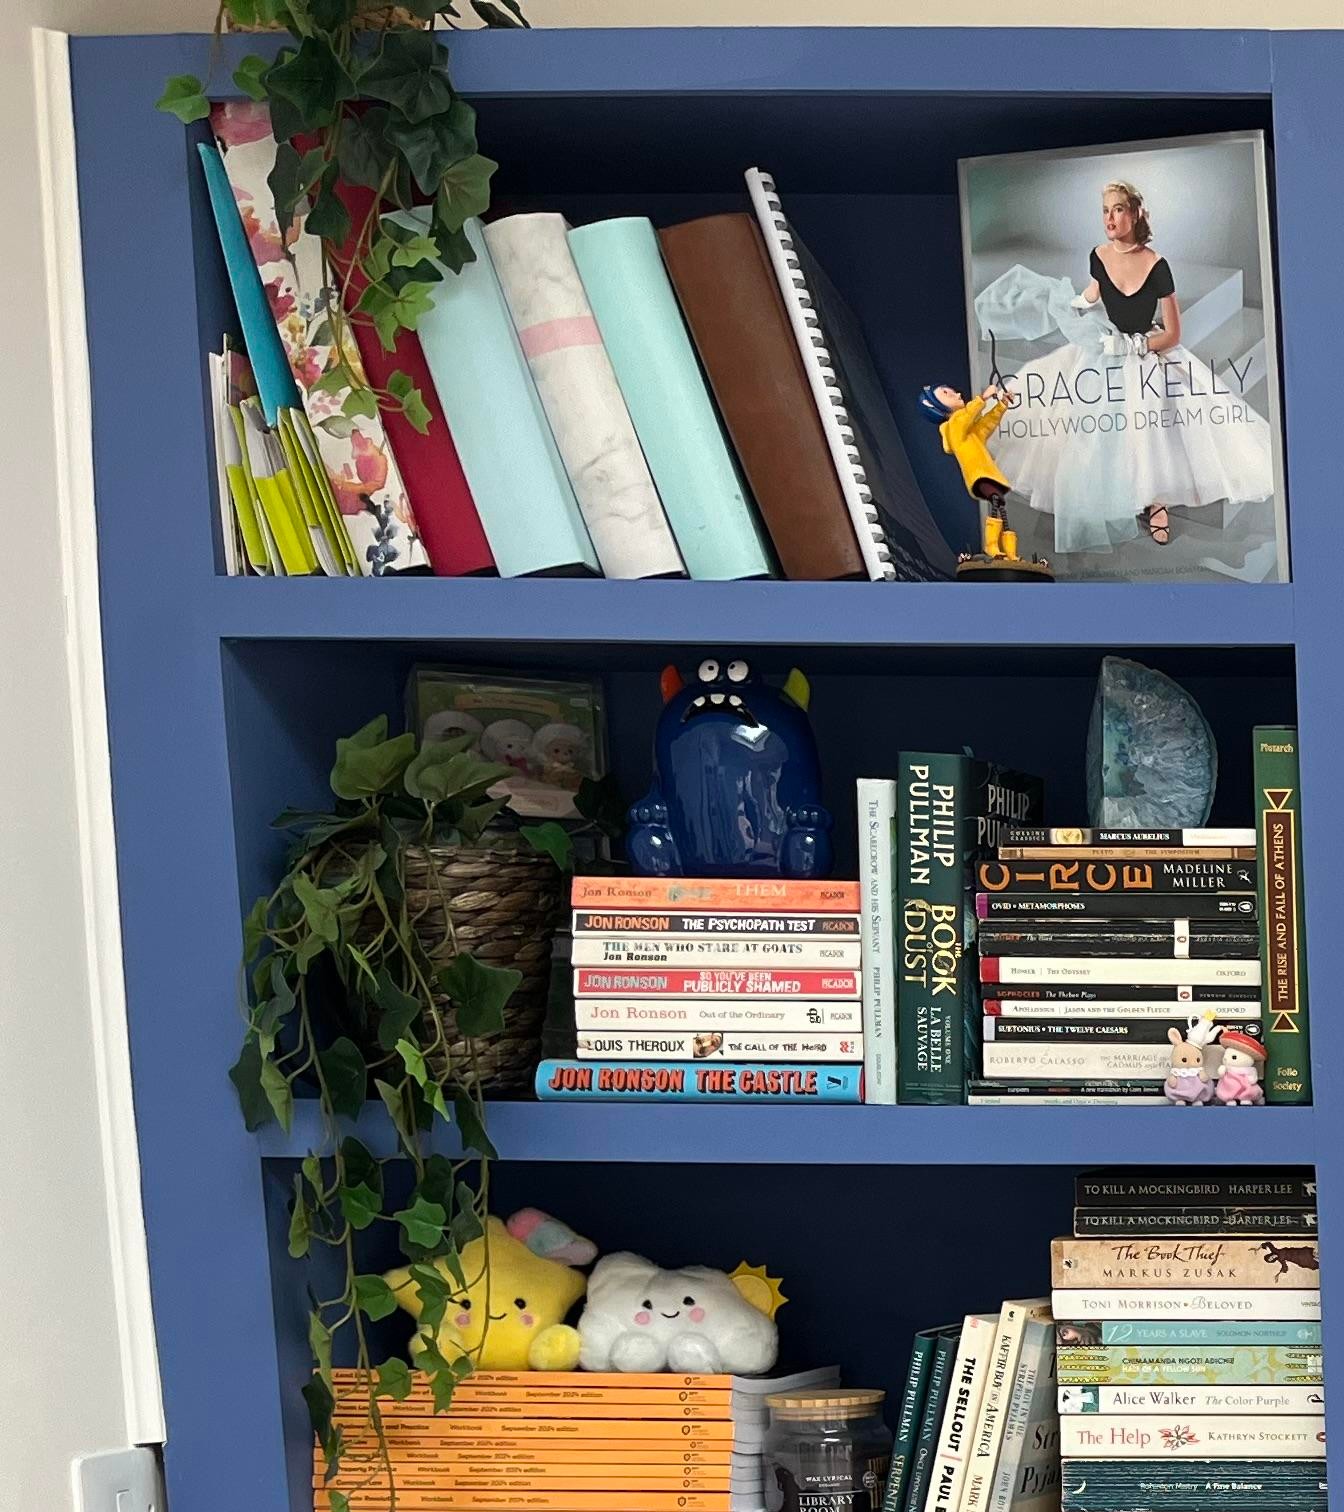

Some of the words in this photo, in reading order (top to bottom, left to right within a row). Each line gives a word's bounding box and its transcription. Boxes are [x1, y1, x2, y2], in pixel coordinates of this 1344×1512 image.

[998, 366, 1125, 412] GRACE
[1139, 356, 1253, 401] KELLY
[999, 413, 1128, 440] HOLLYWOOD
[1134, 407, 1203, 430] DREAM
[1209, 404, 1256, 425] GIRL
[909, 764, 931, 886] PULLMAN
[932, 782, 955, 868] PHILIP
[1163, 864, 1233, 875] MADELINE
[1172, 876, 1226, 889] MILLER
[586, 1039, 622, 1053] LOUIS
[626, 1039, 684, 1052] THEROUX
[1077, 1430, 1103, 1446] The
[1110, 1427, 1151, 1449] Help
[799, 1495, 855, 1507] LIBRARY
